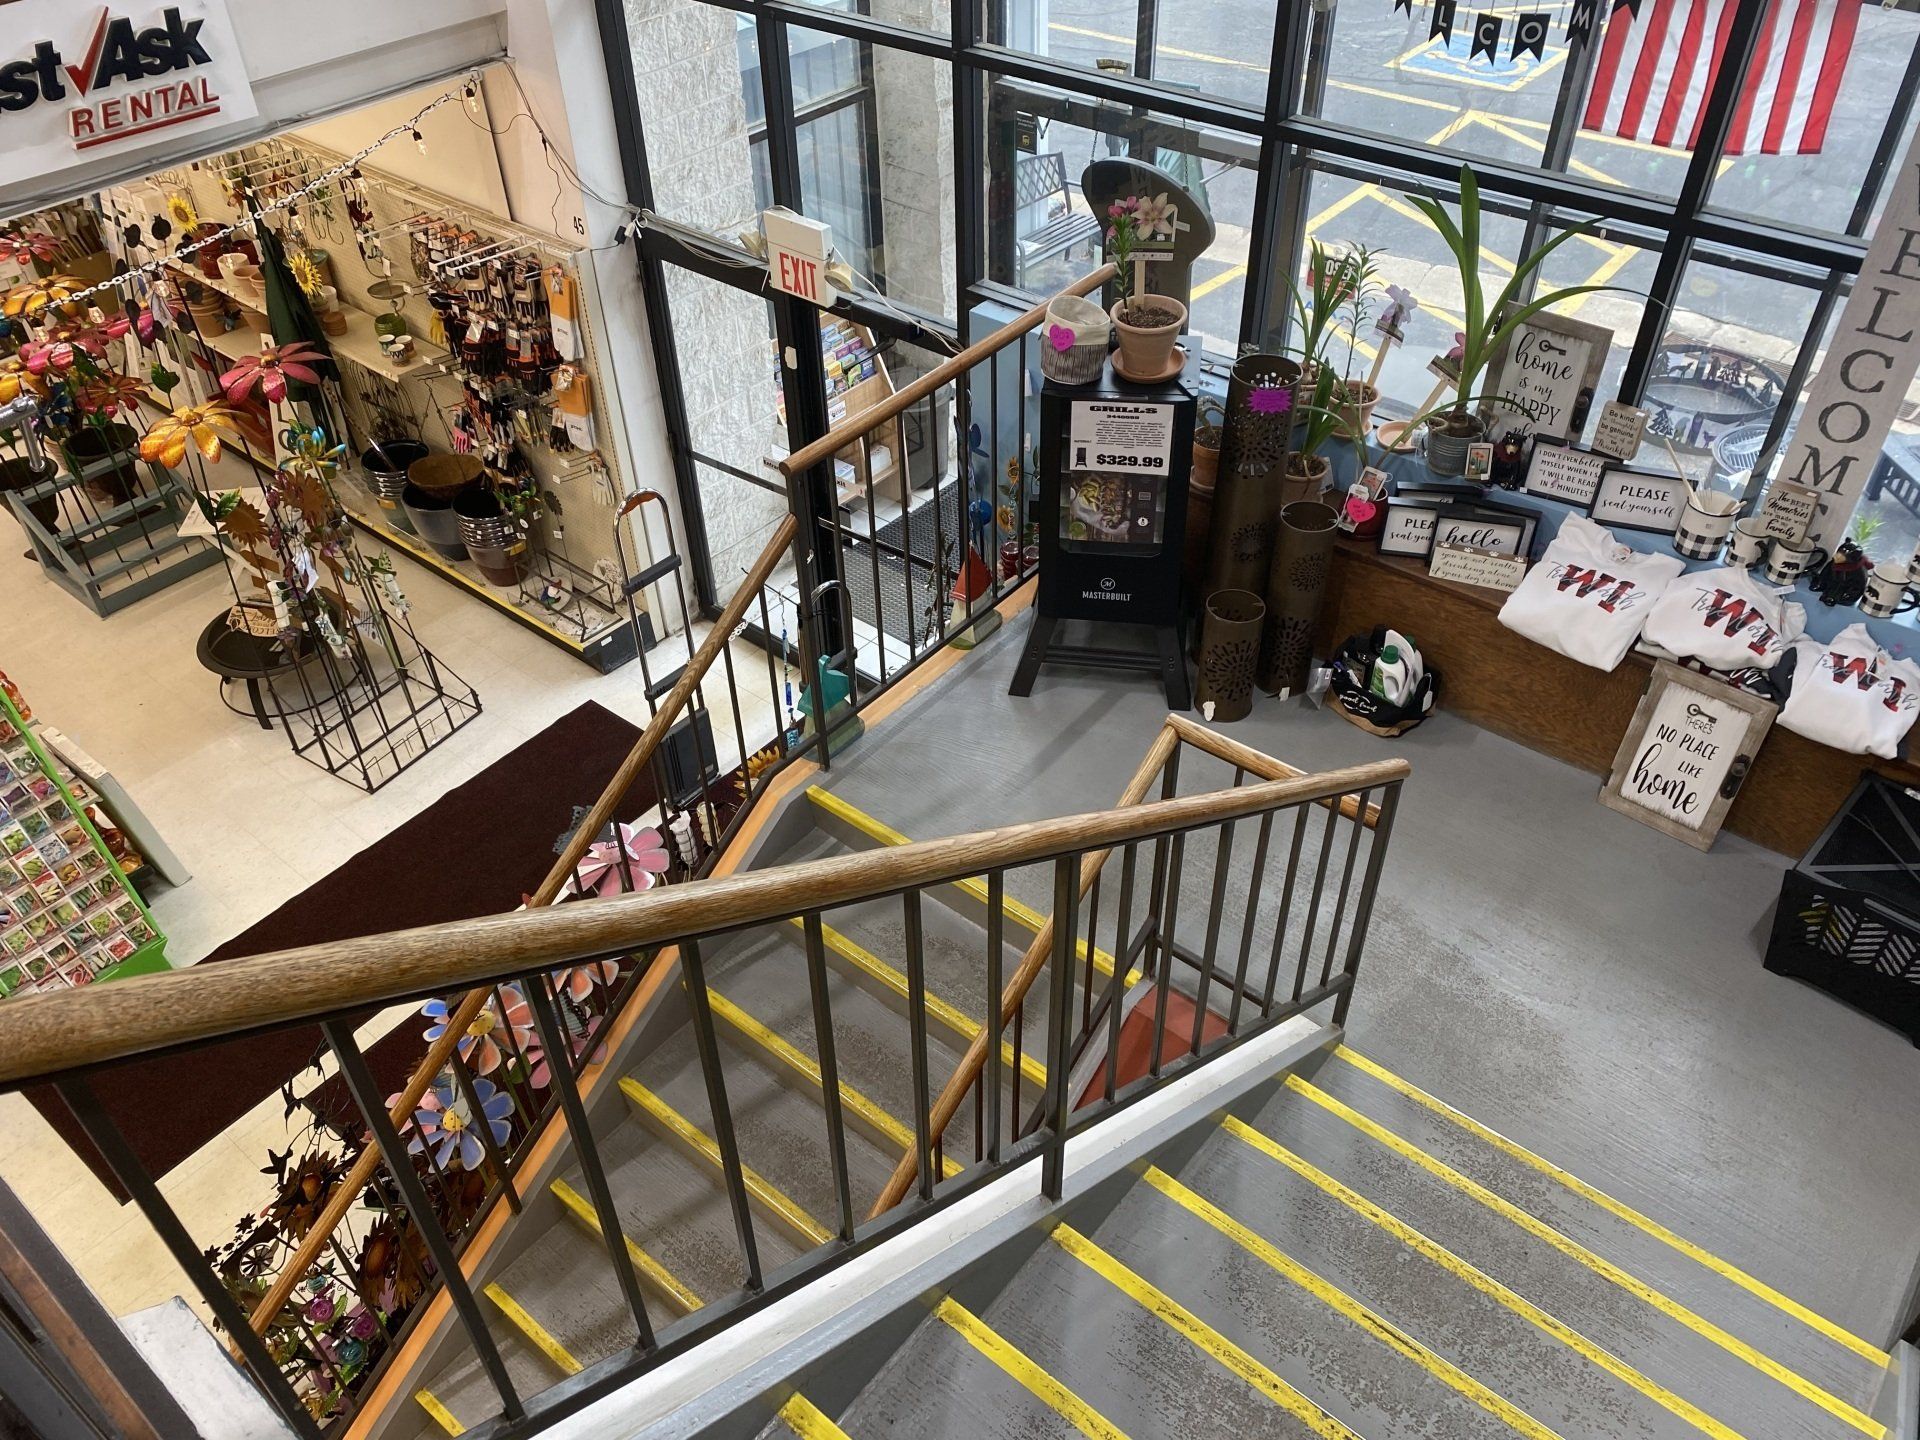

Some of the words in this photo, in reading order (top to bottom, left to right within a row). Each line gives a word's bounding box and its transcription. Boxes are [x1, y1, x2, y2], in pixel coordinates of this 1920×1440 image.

[1438, 5, 1591, 46] LCOM
[0, 40, 67, 112] st
[91, 6, 213, 90] Ask
[70, 77, 220, 137] RENTAL
[573, 215, 585, 235] 45
[779, 251, 817, 301] EXIT
[1515, 331, 1574, 381] home
[1789, 163, 1920, 542] ELCOM
[1519, 376, 1529, 388] is
[1534, 383, 1553, 402] my
[1089, 405, 1158, 414] GRILLS
[1501, 390, 1561, 426] HAPPY
[1096, 453, 1164, 468] $329.99
[1541, 459, 1566, 470] MYSELF
[1567, 465, 1588, 476] WHEN
[1543, 450, 1562, 459] DON'T
[1563, 455, 1578, 463] EVEN
[1578, 455, 1601, 468] belie
[1540, 479, 1549, 487] IN
[1548, 471, 1565, 481] WILL
[1566, 475, 1576, 483] BE
[1577, 479, 1597, 488] READ
[1619, 484, 1671, 502] PLEASE
[1602, 498, 1626, 510] seat
[1625, 502, 1676, 518] yourself
[1404, 517, 1434, 530] PLEA
[1445, 525, 1503, 548] hello
[1082, 590, 1133, 602] MASTERBUILT
[1557, 564, 1635, 614] WI
[1703, 588, 1779, 657] WI
[1685, 715, 1715, 735] THERE'S
[1656, 723, 1678, 743] NO
[1679, 733, 1720, 761] PLACE
[1632, 742, 1700, 815] home
[1677, 760, 1705, 779] LIKE
